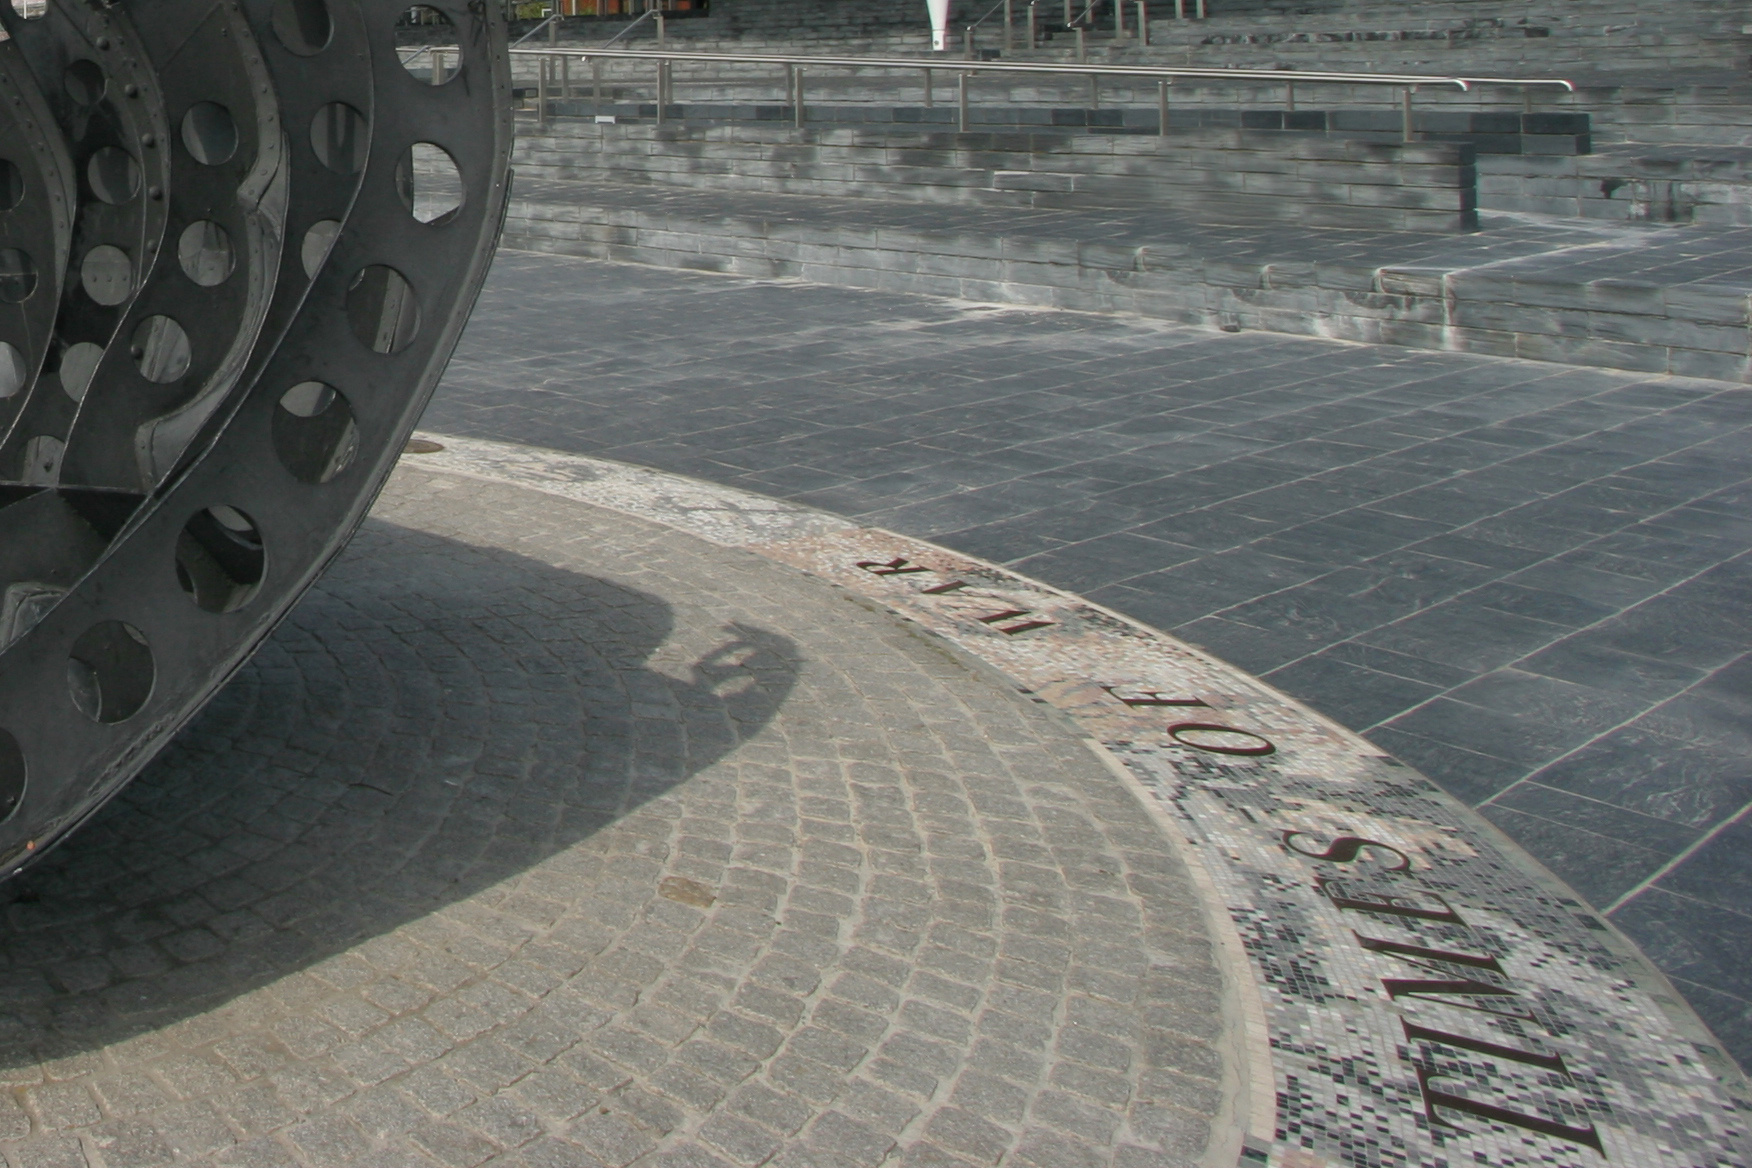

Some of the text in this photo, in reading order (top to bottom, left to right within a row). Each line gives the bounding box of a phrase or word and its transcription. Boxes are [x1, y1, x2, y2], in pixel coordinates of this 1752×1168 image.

[855, 556, 1608, 1160] TIMES OF WAR
